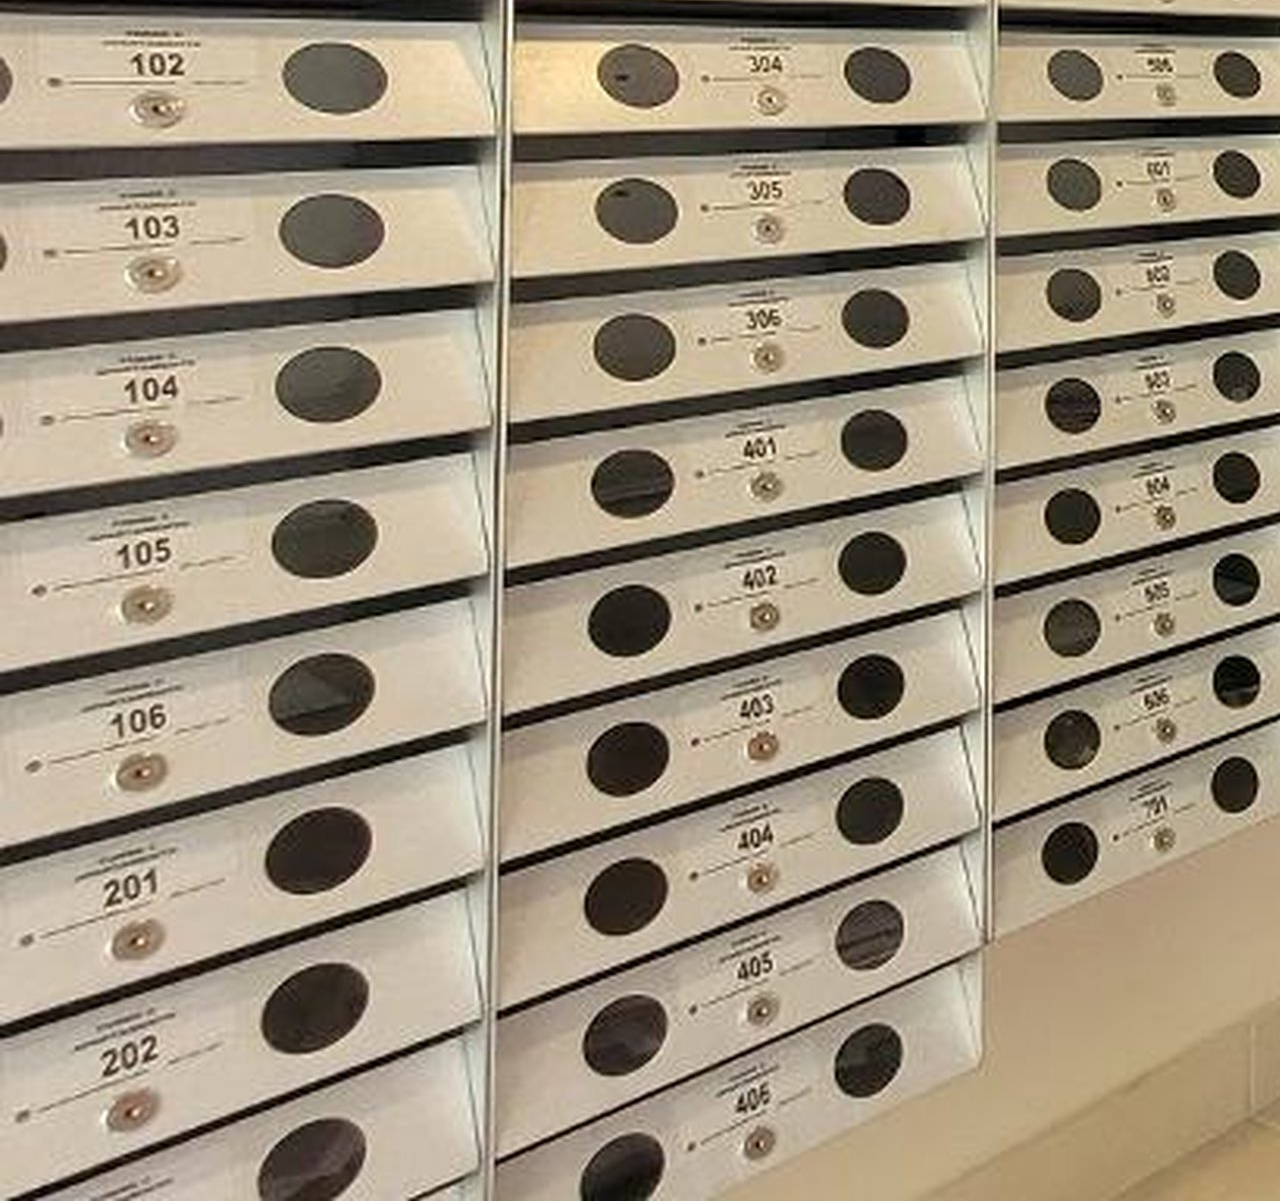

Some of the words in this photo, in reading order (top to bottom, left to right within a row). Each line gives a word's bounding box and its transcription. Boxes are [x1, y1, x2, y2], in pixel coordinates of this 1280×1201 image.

[131, 53, 185, 76] 102
[749, 56, 783, 74] 304
[747, 182, 783, 201] 305
[125, 215, 180, 240] 103
[746, 309, 782, 330] 306
[124, 375, 178, 403] 104
[743, 437, 777, 459] 401
[116, 539, 171, 569] 105
[742, 566, 777, 590] 402
[739, 695, 774, 719] 403
[111, 704, 166, 739] 106
[738, 825, 774, 851] 404
[104, 870, 159, 907] 201
[737, 953, 773, 982] 405
[102, 1036, 159, 1076] 202
[735, 1084, 771, 1114] 406
